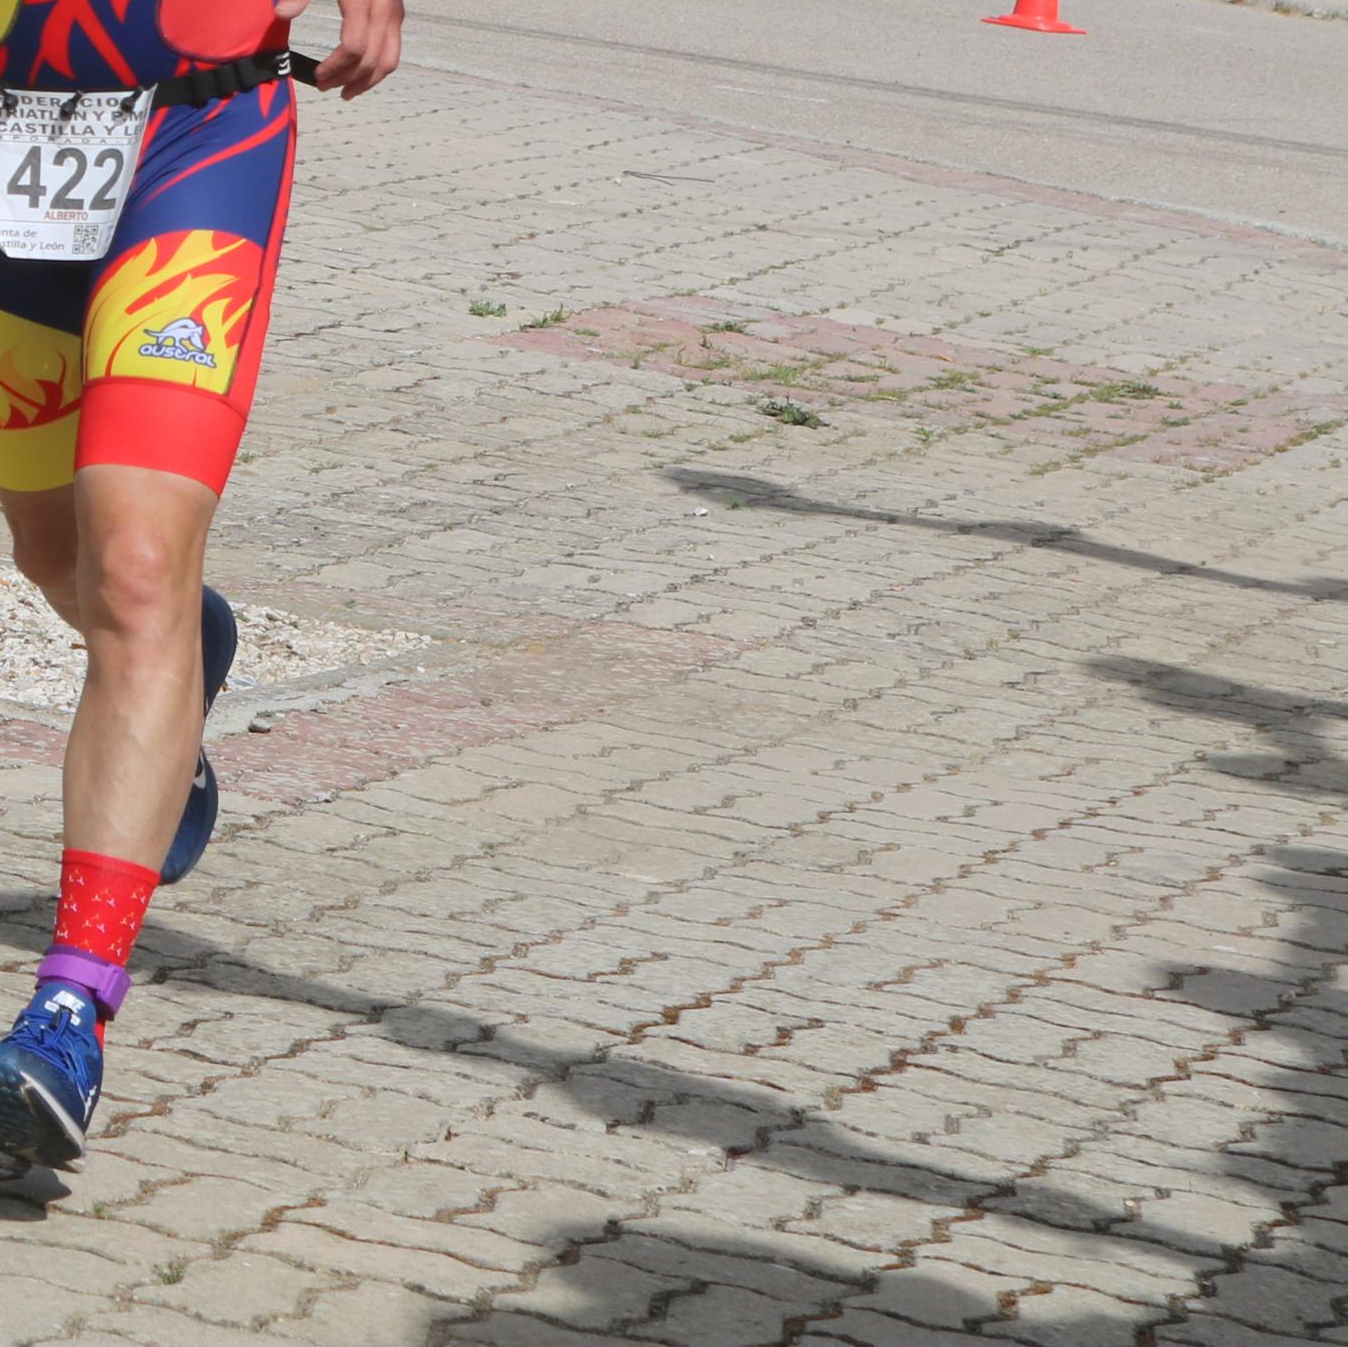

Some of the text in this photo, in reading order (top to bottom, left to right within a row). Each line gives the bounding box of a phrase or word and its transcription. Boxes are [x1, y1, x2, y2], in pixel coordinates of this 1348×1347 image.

[93, 110, 109, 121] Y
[104, 125, 116, 136] Y
[7, 145, 124, 210] 422
[44, 210, 89, 221] ALBERTO
[24, 229, 37, 238] de
[30, 242, 37, 252] y
[40, 240, 65, 251] León
